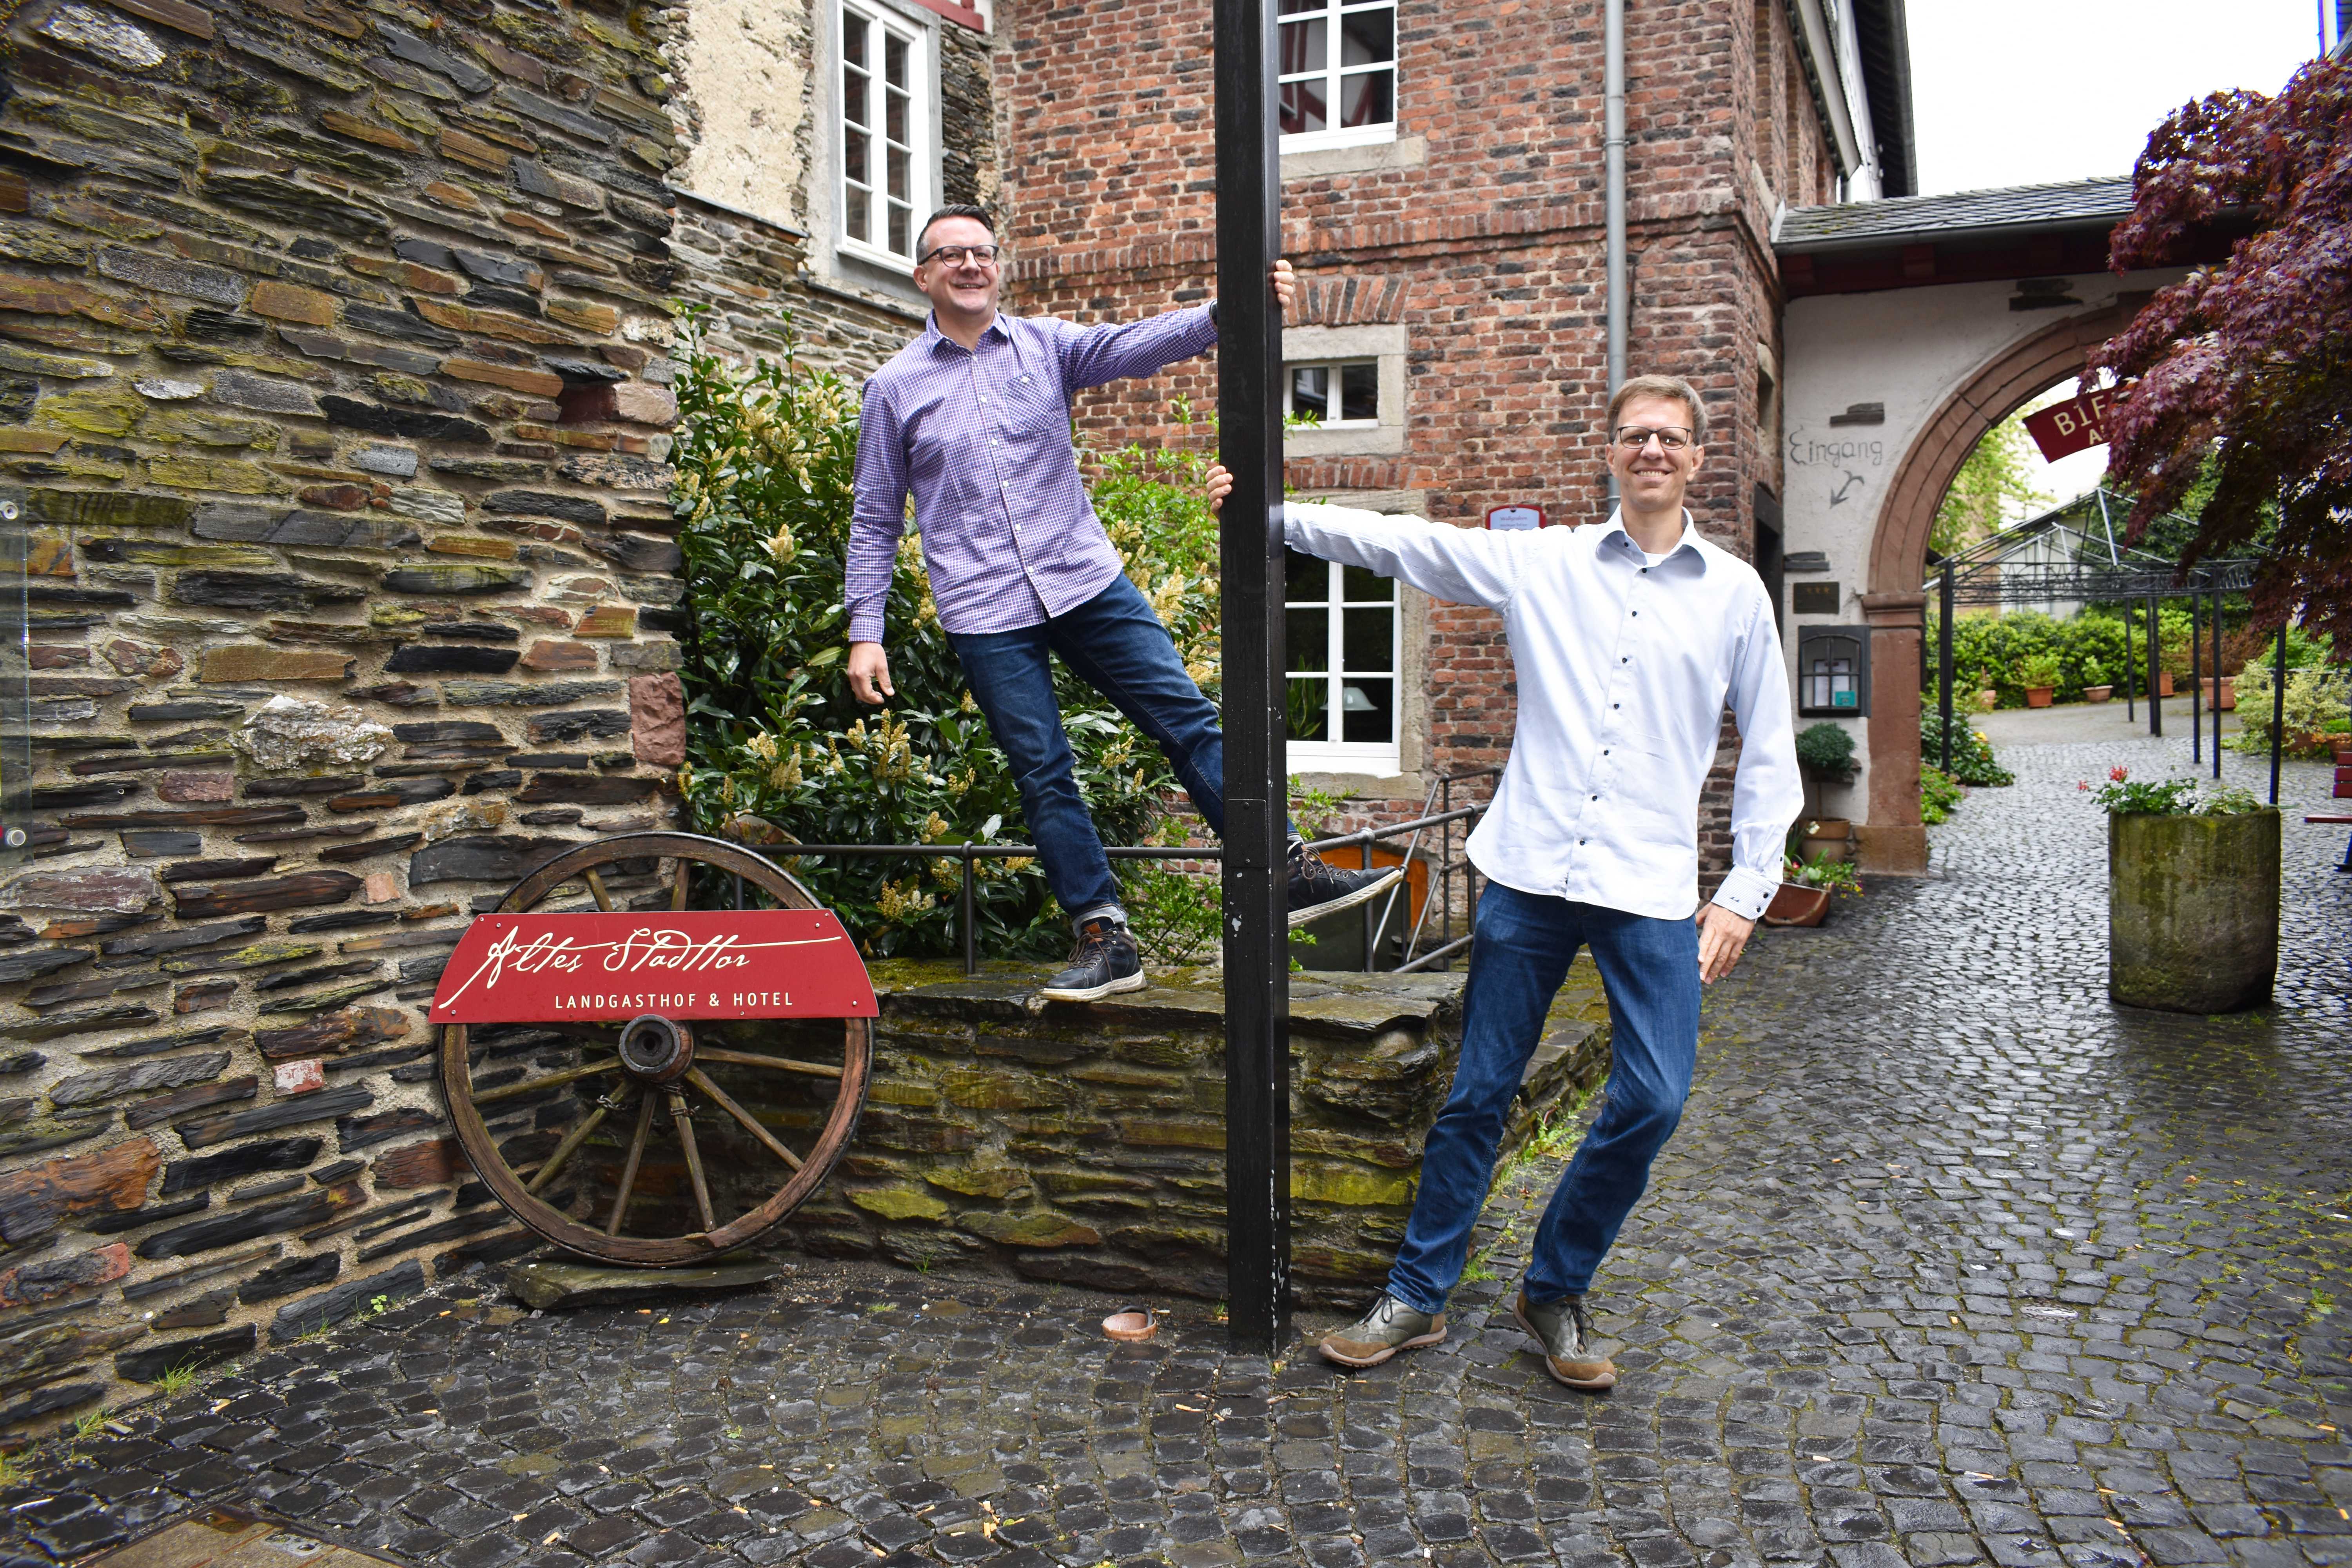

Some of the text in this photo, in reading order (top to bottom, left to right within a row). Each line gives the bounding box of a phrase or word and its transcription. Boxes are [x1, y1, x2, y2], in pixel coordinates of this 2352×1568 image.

[1789, 425, 1882, 468] Eingang
[439, 926, 842, 1009] Altes Stadttor
[555, 992, 793, 1009] LANDGASTHOF & HOTEL
